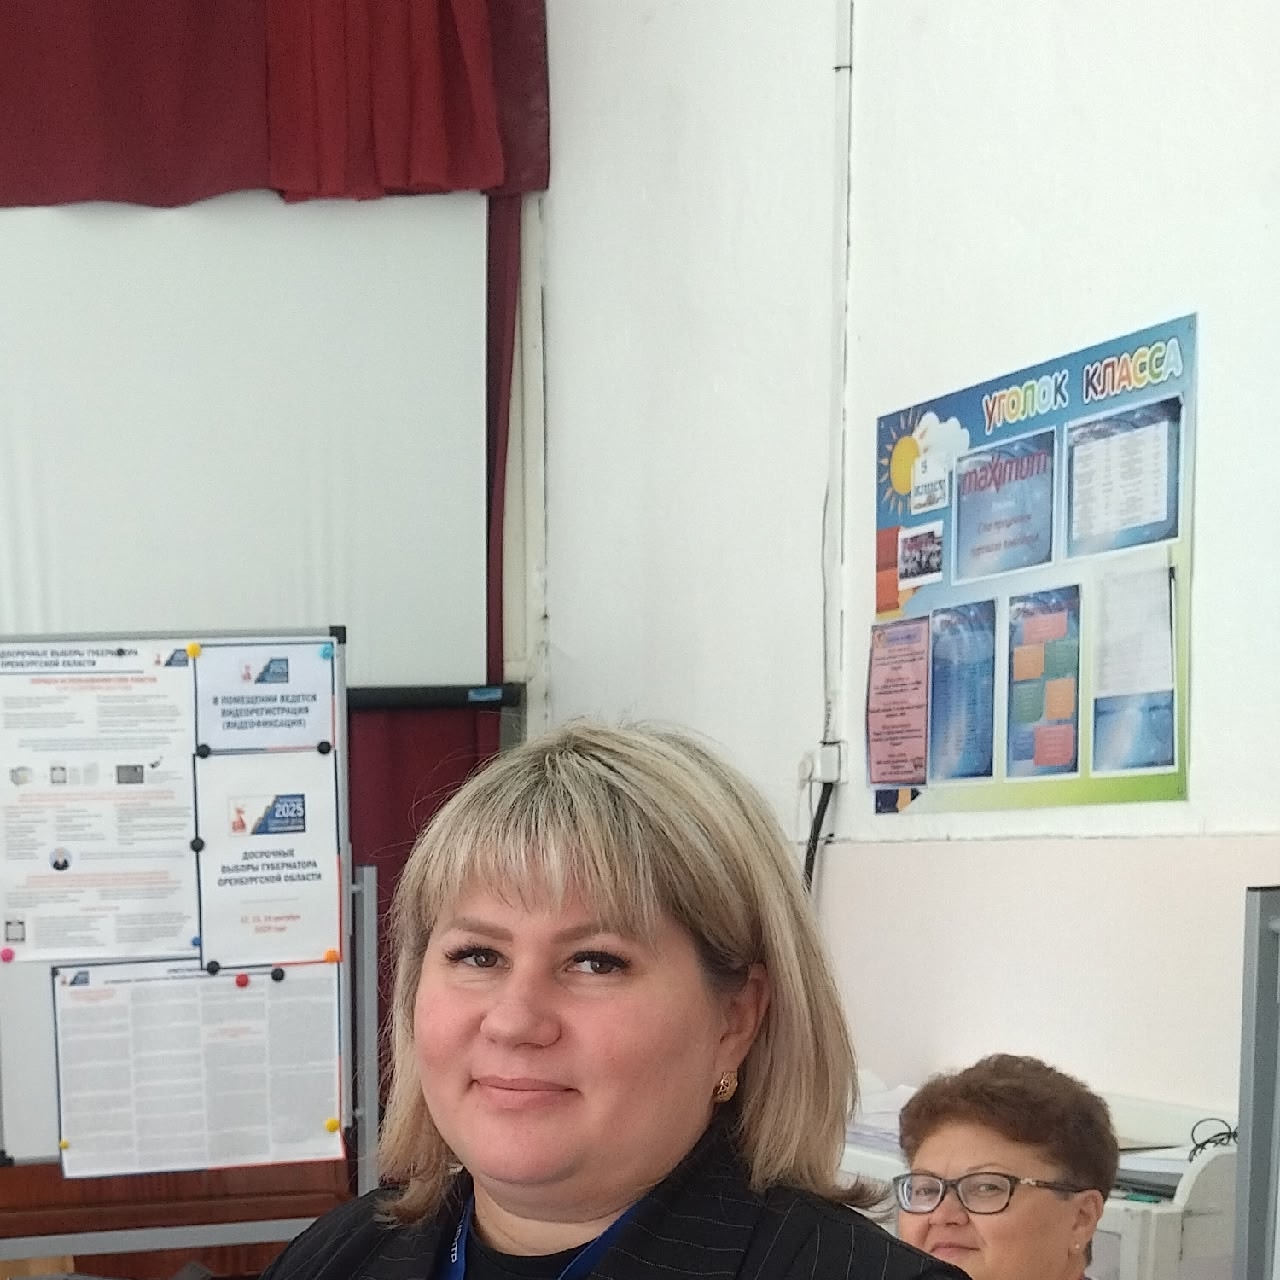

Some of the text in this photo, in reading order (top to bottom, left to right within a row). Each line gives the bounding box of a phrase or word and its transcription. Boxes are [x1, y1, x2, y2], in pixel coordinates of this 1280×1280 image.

[983, 338, 1184, 434] УГОЛОК КЛАССА
[274, 802, 304, 818] 2025
